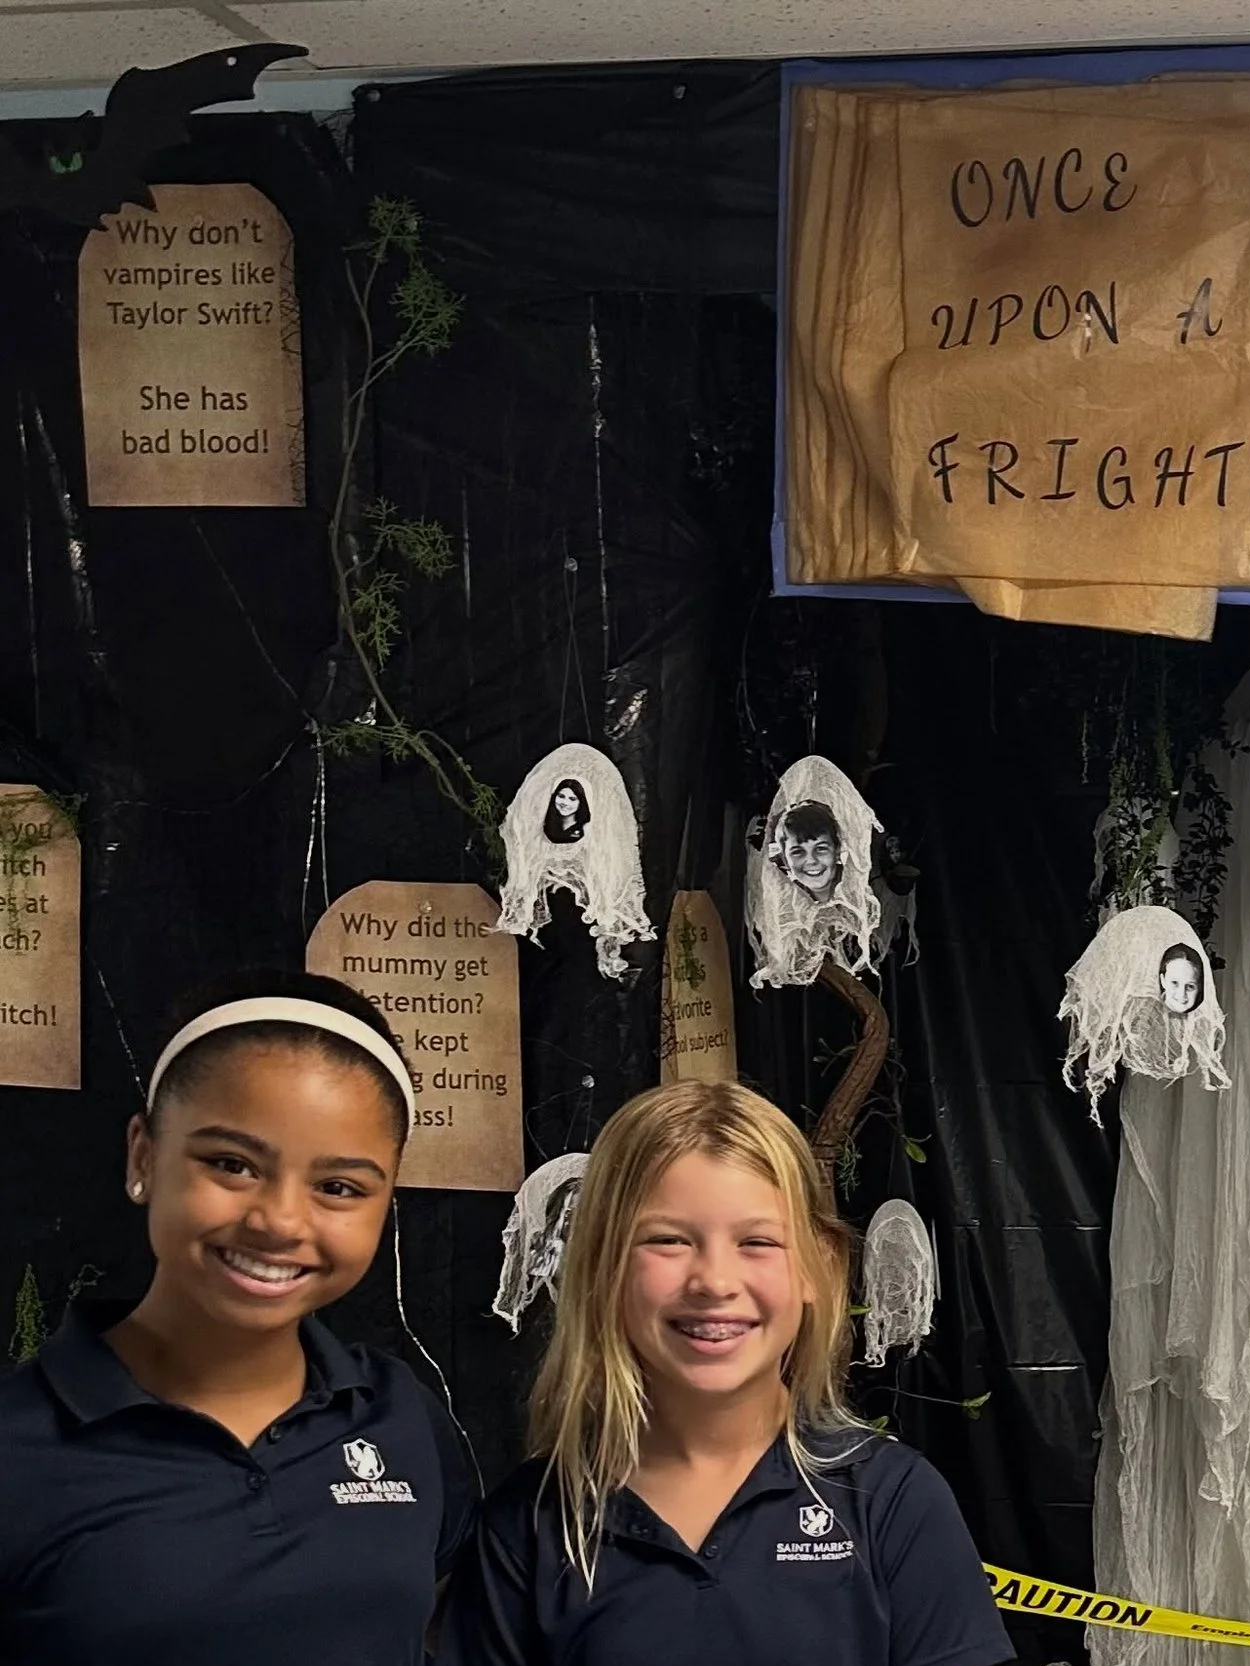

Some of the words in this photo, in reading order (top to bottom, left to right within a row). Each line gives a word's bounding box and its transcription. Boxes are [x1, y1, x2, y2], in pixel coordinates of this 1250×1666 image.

[951, 148, 1138, 228] ONCE
[115, 219, 178, 250] Why
[103, 263, 222, 290] vampires
[231, 261, 275, 285] like
[107, 301, 188, 330] Taylor
[198, 300, 273, 325] Swift?
[931, 281, 1120, 354] UPON
[1176, 277, 1223, 345] A
[140, 385, 190, 411] She
[201, 385, 248, 411] has
[122, 429, 170, 455] bad
[181, 428, 269, 454] blood!
[0, 853, 46, 877] itch
[25, 894, 49, 914] at
[0, 928, 42, 951] ch?
[340, 912, 398, 941] Why
[407, 916, 446, 938] did
[455, 917, 491, 939] the
[342, 955, 447, 981] mummy
[454, 956, 489, 981] get
[0, 1003, 58, 1027] itch!
[361, 989, 485, 1015] etention?
[415, 1029, 469, 1057] kept
[432, 1068, 508, 1096] during
[413, 1106, 454, 1128] ass!
[776, 1542, 812, 1553] SAINT
